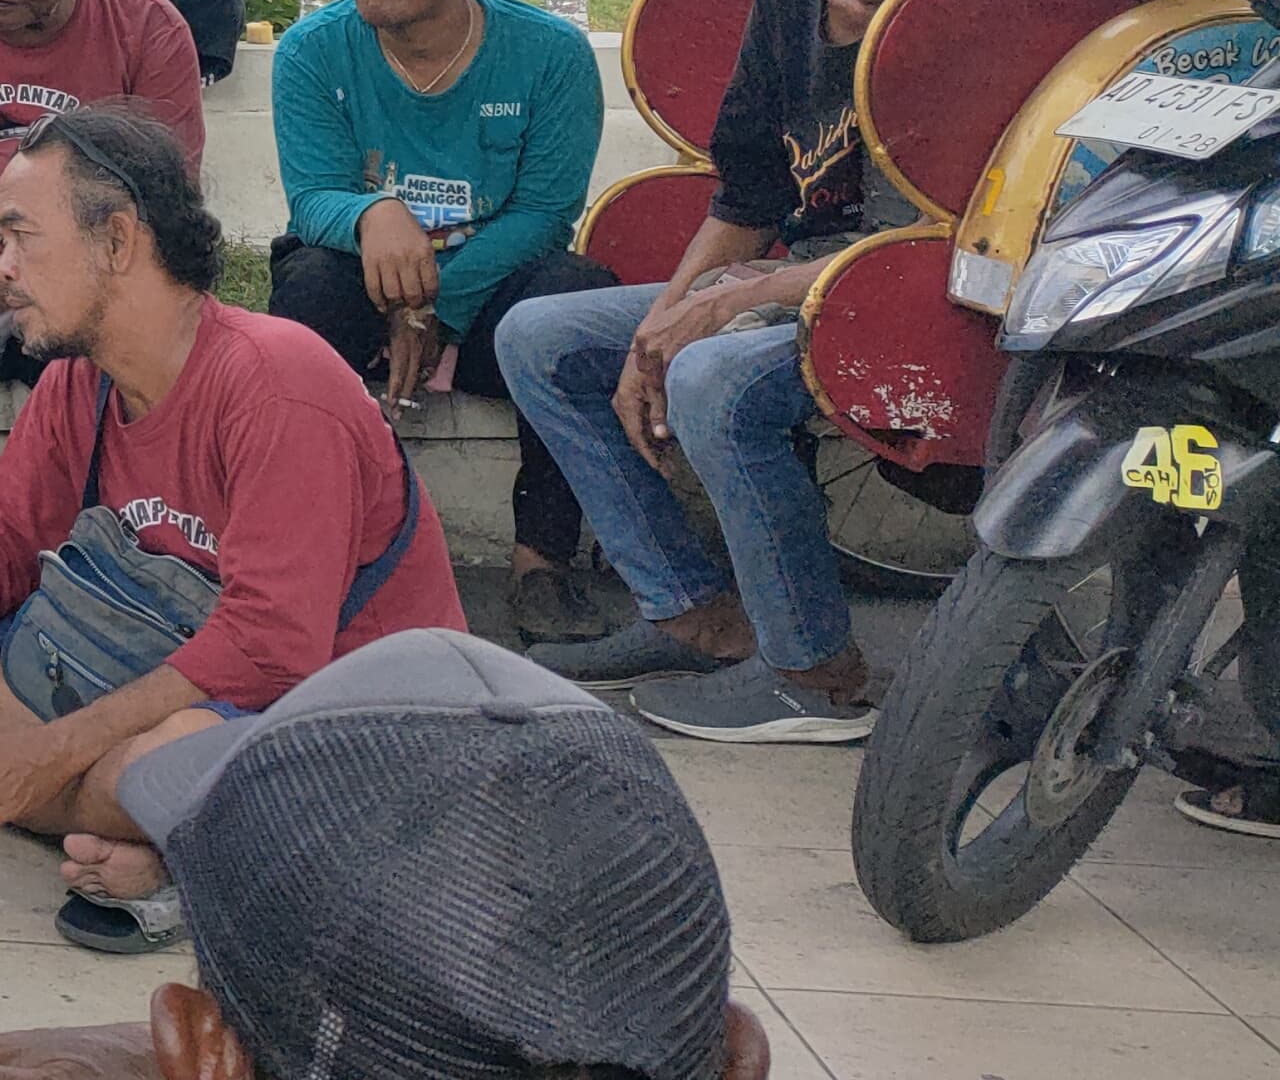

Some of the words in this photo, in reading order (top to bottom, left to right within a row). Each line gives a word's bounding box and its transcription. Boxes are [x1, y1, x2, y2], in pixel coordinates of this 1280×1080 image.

[1154, 39, 1240, 76] Becak
[493, 102, 521, 117] BNI
[1100, 77, 1154, 103] AD
[1144, 83, 1228, 113] 4531
[1213, 91, 1275, 121] FS
[395, 189, 468, 206] NGANGGO
[407, 178, 467, 195] MBECAK
[1121, 424, 1223, 510] 46
